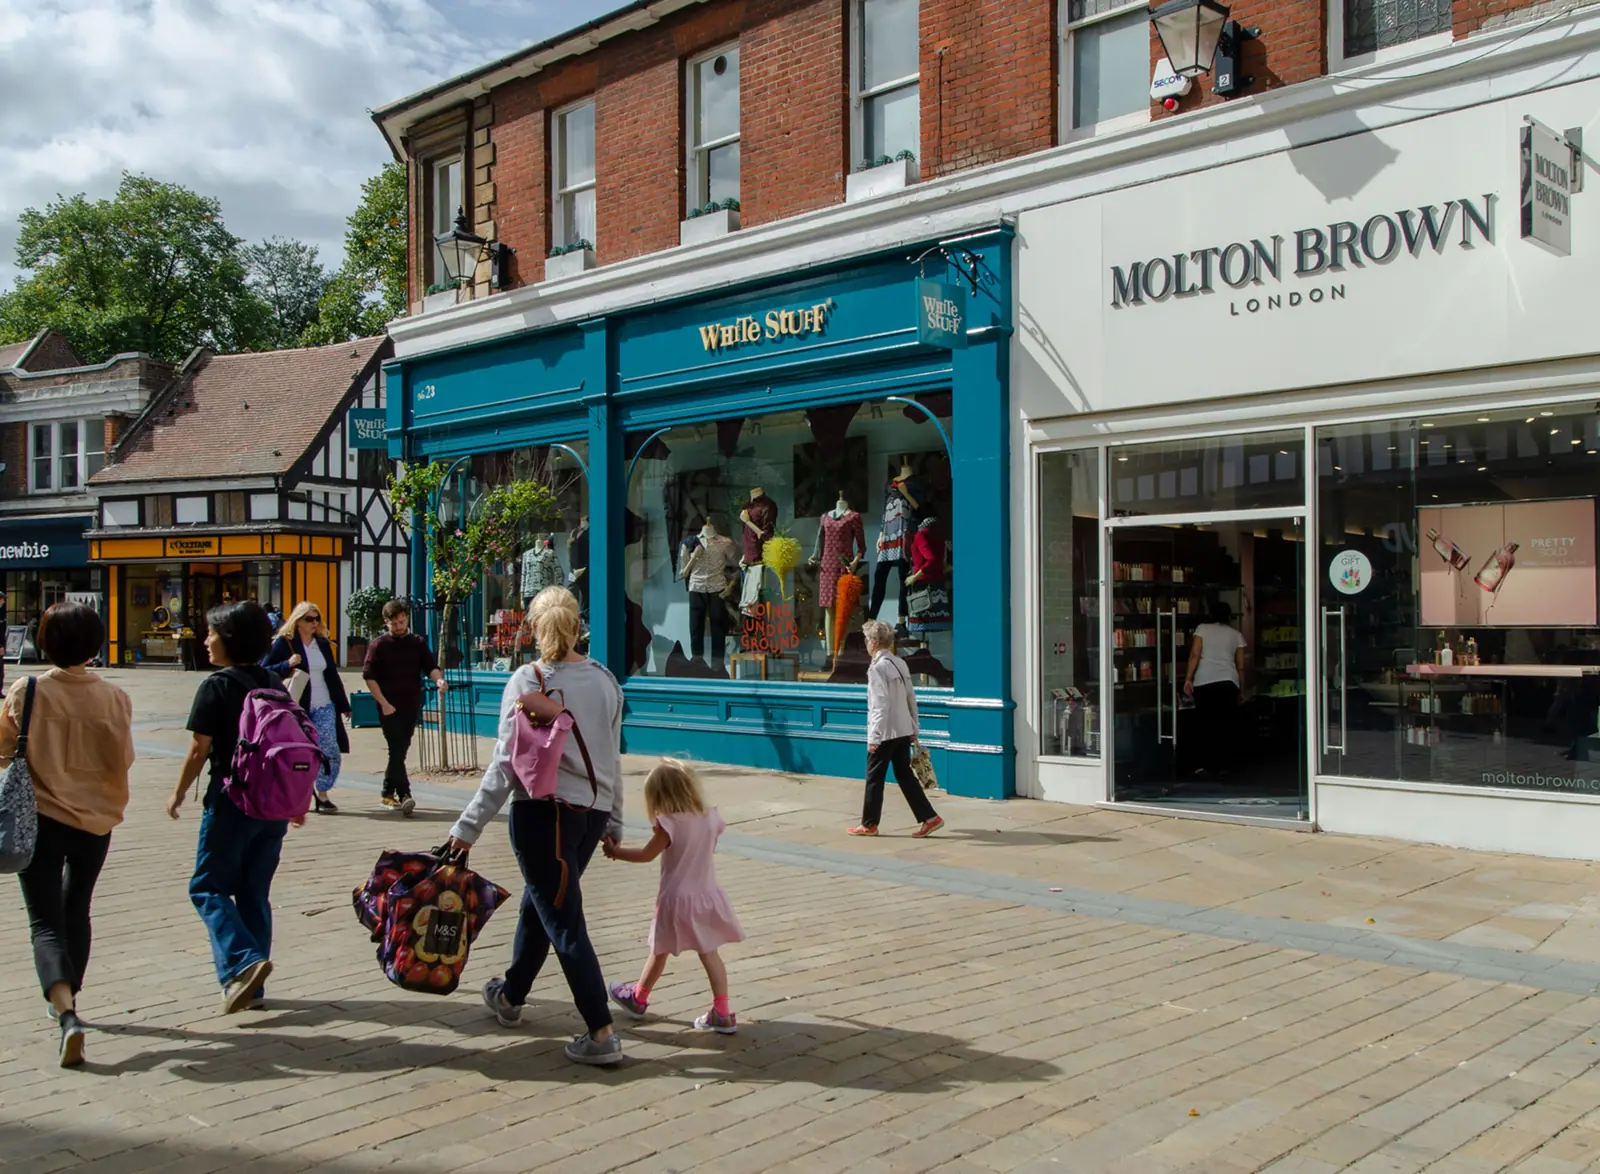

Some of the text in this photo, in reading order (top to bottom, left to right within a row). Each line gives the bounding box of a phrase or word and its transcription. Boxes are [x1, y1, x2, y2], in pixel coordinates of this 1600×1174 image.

[1221, 75, 1228, 86] 2
[1535, 152, 1568, 190] MOLTON
[1535, 180, 1568, 216] BROWN
[1109, 193, 1497, 308] MOLTON BROWN
[1230, 283, 1346, 316] LONDON
[425, 385, 435, 398] 23
[0, 541, 49, 559] newbie
[1531, 537, 1576, 547] PRETTY
[1341, 557, 1360, 566] GIFT
[746, 602, 791, 620] GOING
[745, 617, 798, 637] UNDER
[741, 634, 800, 656] GROUND
[1482, 771, 1600, 790] moltonbrown.c
[434, 924, 457, 937] M&S
